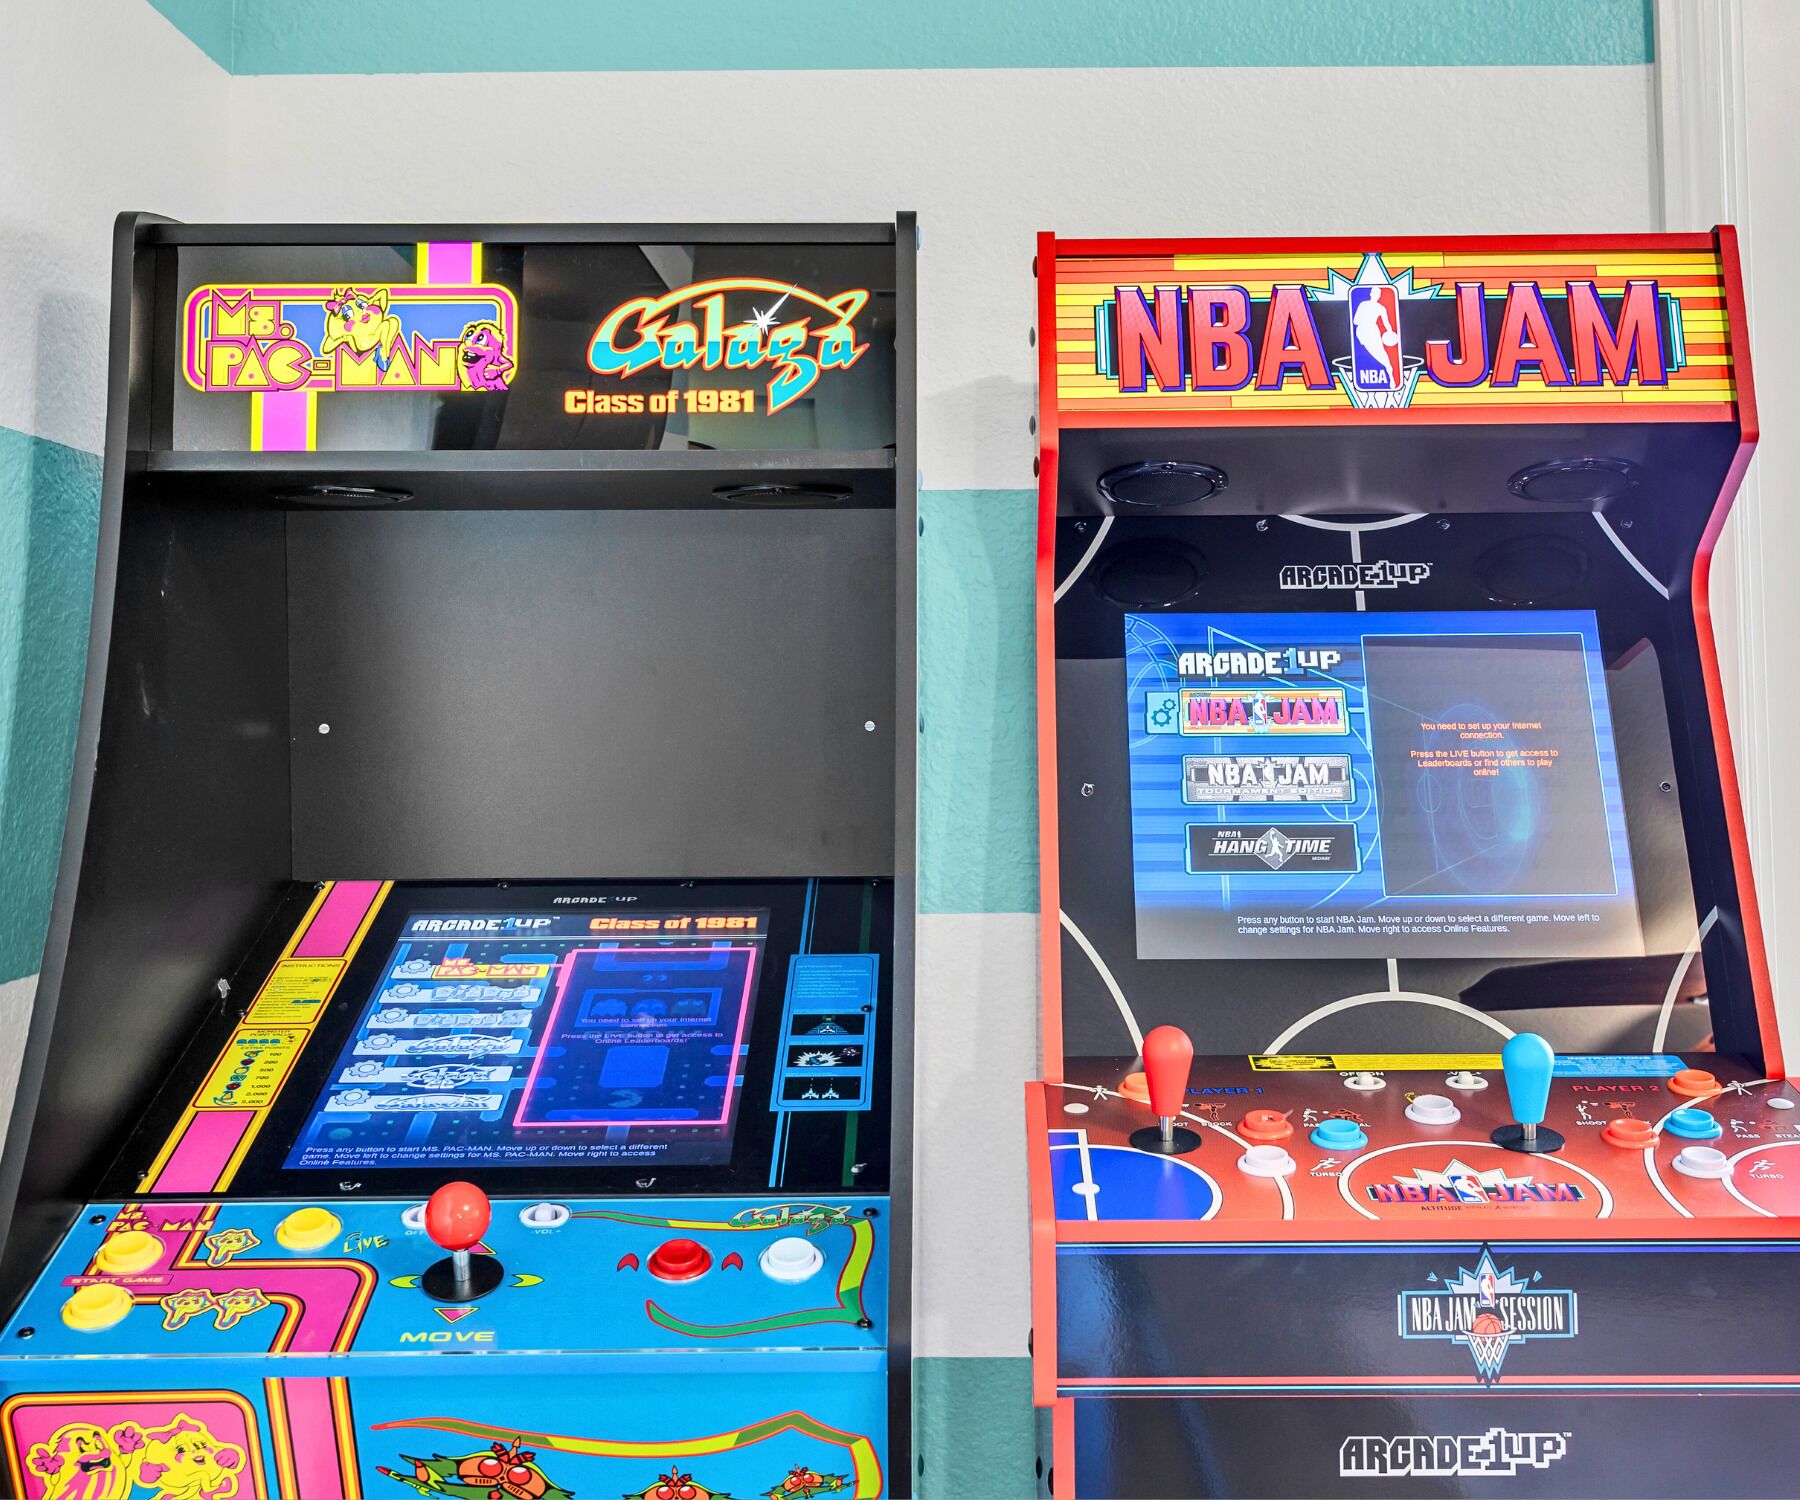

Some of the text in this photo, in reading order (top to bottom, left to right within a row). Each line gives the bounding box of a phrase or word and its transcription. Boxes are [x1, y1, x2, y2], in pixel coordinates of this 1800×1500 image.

[1114, 280, 1669, 392] NBA JAM
[587, 277, 870, 416] Galaga
[206, 334, 461, 391] PAC-MAN
[1359, 369, 1388, 384] NBA
[564, 389, 754, 414] Class of 1981
[1190, 697, 1338, 725] NBA JAM
[1421, 722, 1435, 730] You
[1437, 722, 1456, 730] need
[1458, 722, 1466, 730] to
[1468, 722, 1480, 730] set
[1482, 723, 1492, 731] up
[1493, 723, 1510, 731] your
[1506, 751, 1518, 759] get
[1536, 759, 1552, 768] play
[1208, 763, 1329, 786] NBA JAM
[1213, 839, 1331, 854] HANG TIME
[589, 917, 757, 930] Class of 1981
[1264, 917, 1278, 925] any
[1402, 916, 1412, 924] up
[1238, 926, 1267, 934] change
[1270, 926, 1300, 934] settings
[1382, 925, 1400, 934] right
[435, 964, 540, 976] PAC-MAN
[1572, 1084, 1643, 1092] PLAYER
[1373, 1183, 1582, 1203] NBA JAM
[728, 1203, 852, 1236] Galaga
[122, 1276, 164, 1284] GAME
[1412, 1296, 1564, 1331] NBA JAM SESSION
[400, 1331, 495, 1342] MOVE
